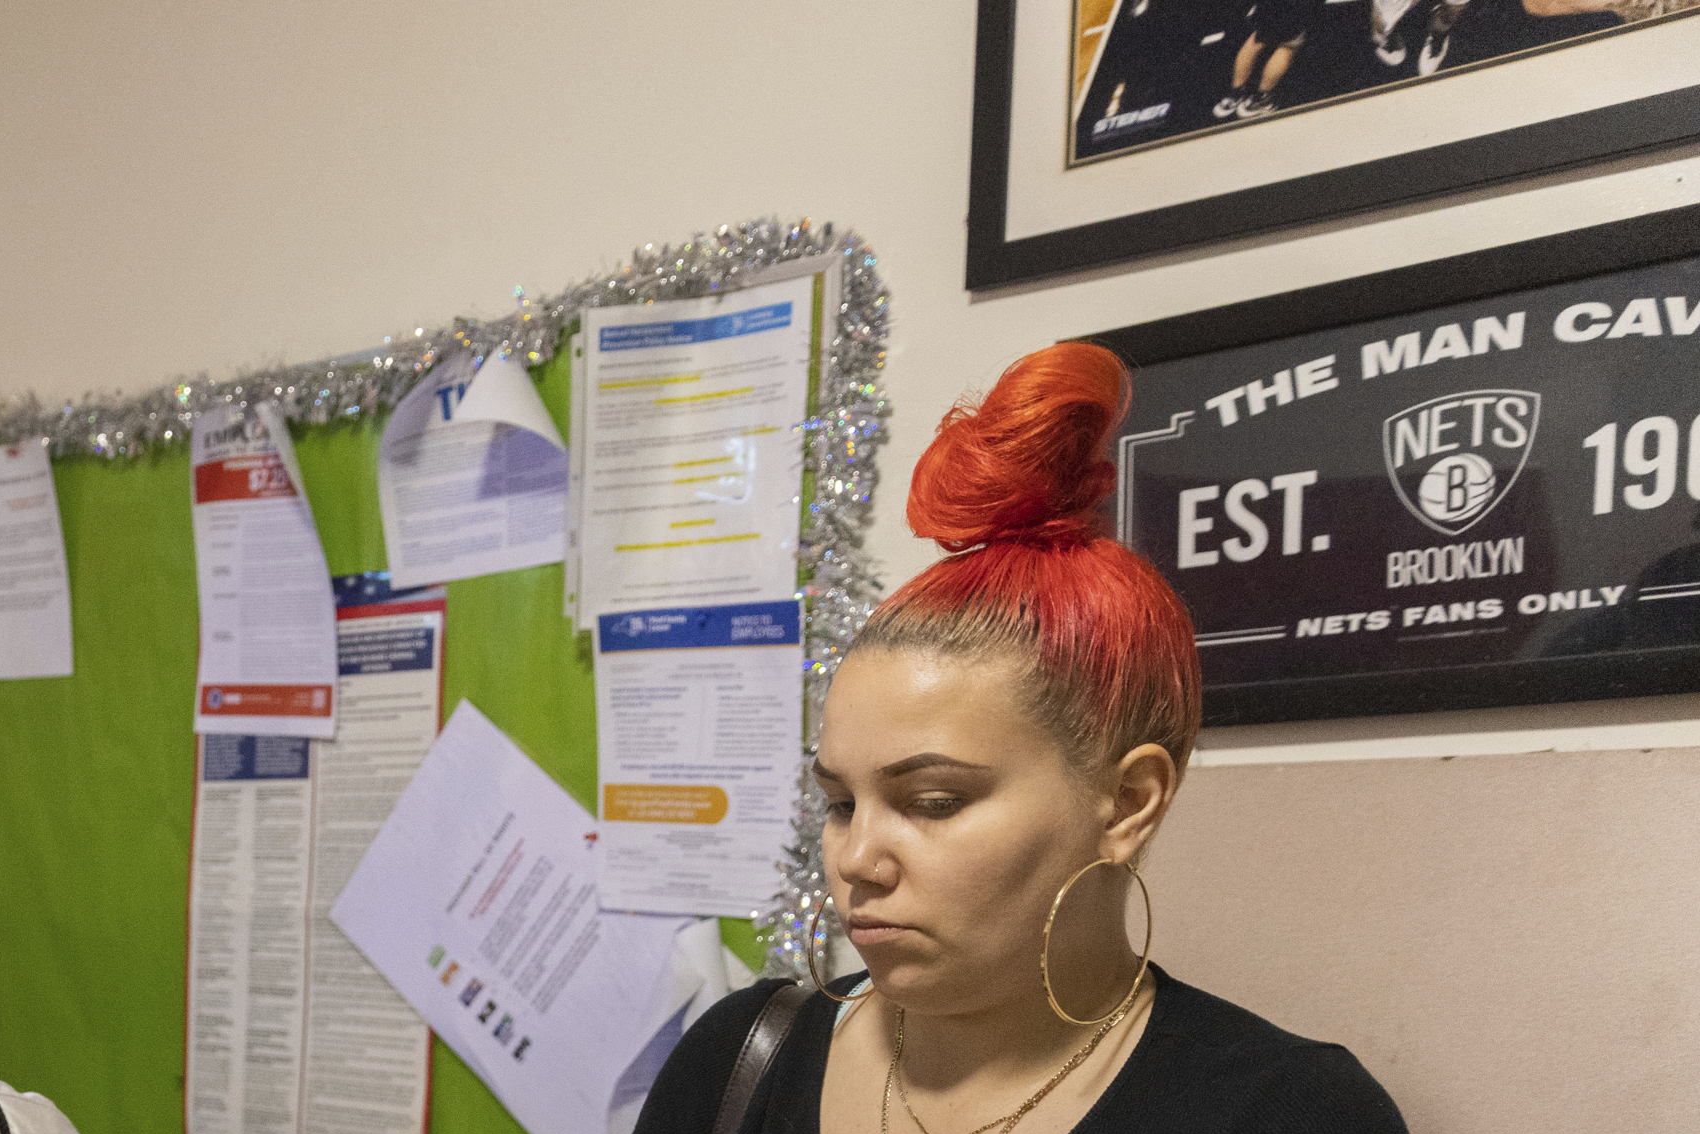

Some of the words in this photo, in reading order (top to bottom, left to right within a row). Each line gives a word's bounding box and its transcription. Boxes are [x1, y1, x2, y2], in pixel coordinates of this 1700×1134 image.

[1093, 102, 1170, 135] STEINER
[1205, 354, 1339, 428] THE
[1361, 311, 1526, 380] MAN
[1394, 396, 1529, 469] NETS
[1177, 470, 1331, 569] EST.
[1386, 536, 1525, 589] BROOKLYN
[1295, 609, 1391, 639] NETS
[1401, 598, 1505, 628] FANS
[1517, 584, 1628, 615] ONLY
